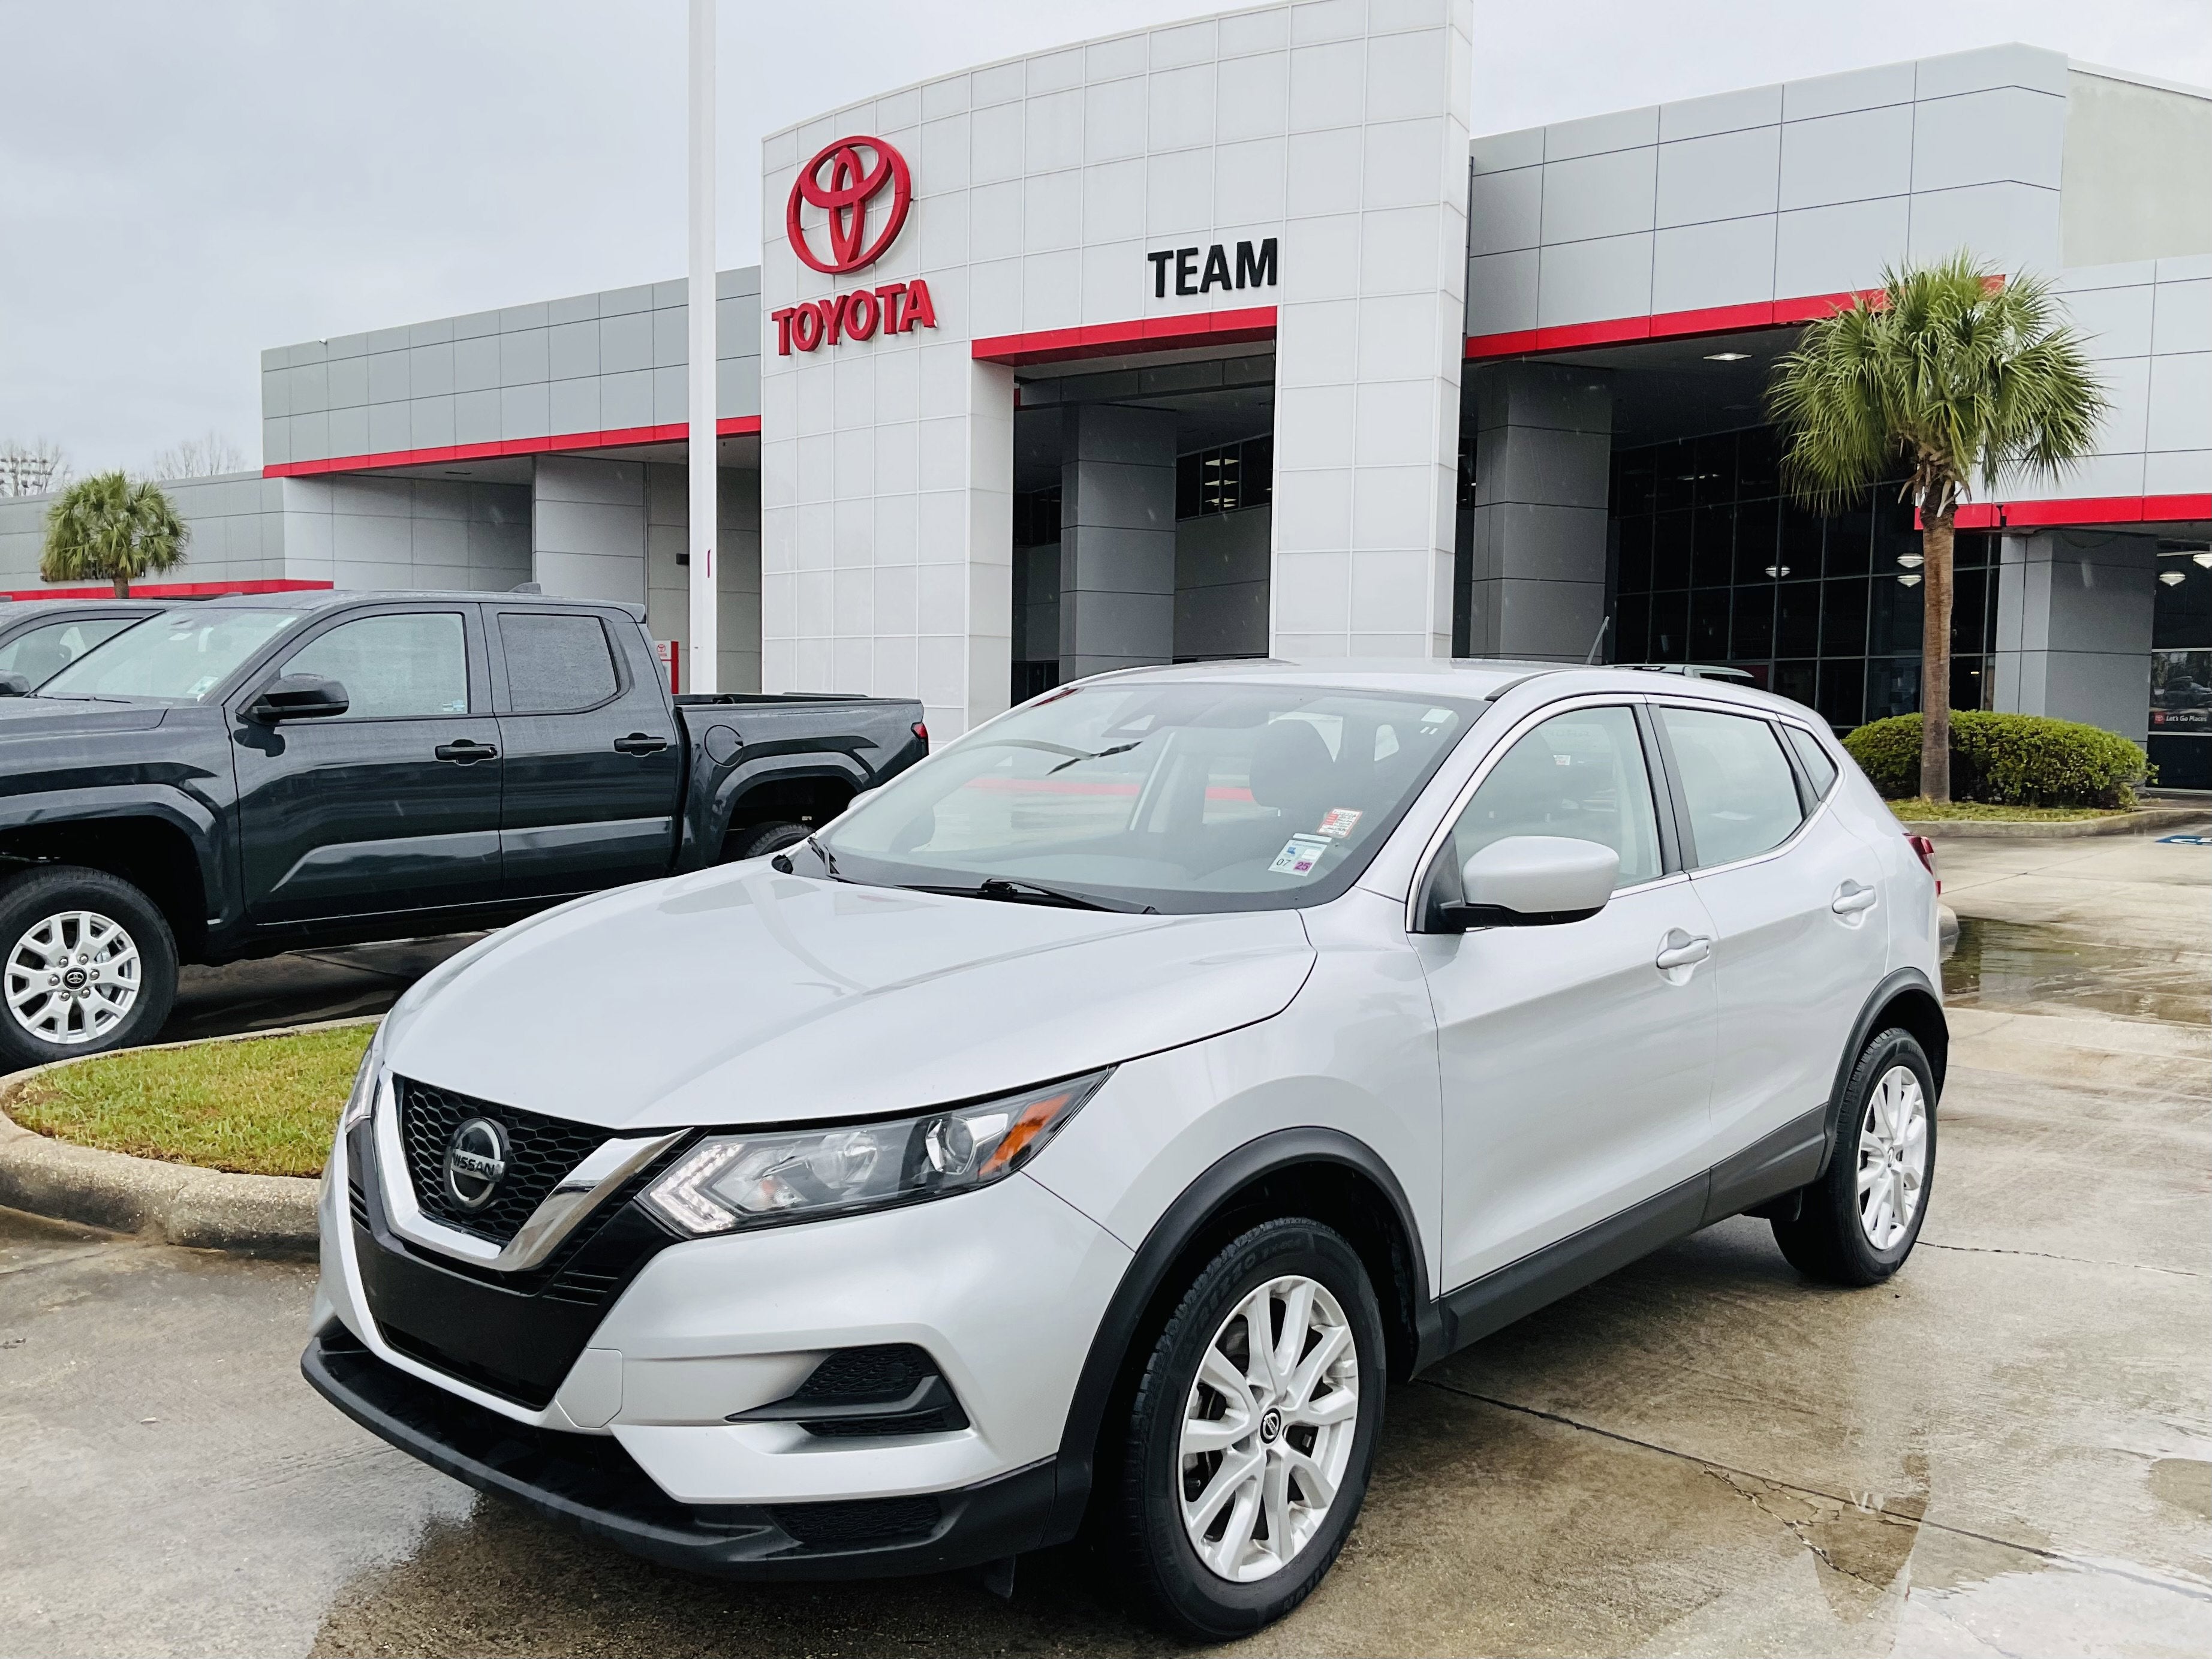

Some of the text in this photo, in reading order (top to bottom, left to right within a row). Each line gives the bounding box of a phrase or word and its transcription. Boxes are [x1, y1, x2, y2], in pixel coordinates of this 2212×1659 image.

[1148, 237, 1277, 297] TEAM
[772, 279, 937, 356] TOYOTA
[1276, 858, 1292, 866] 07
[1295, 862, 1311, 871] 25
[453, 1152, 495, 1176] NISSAN
